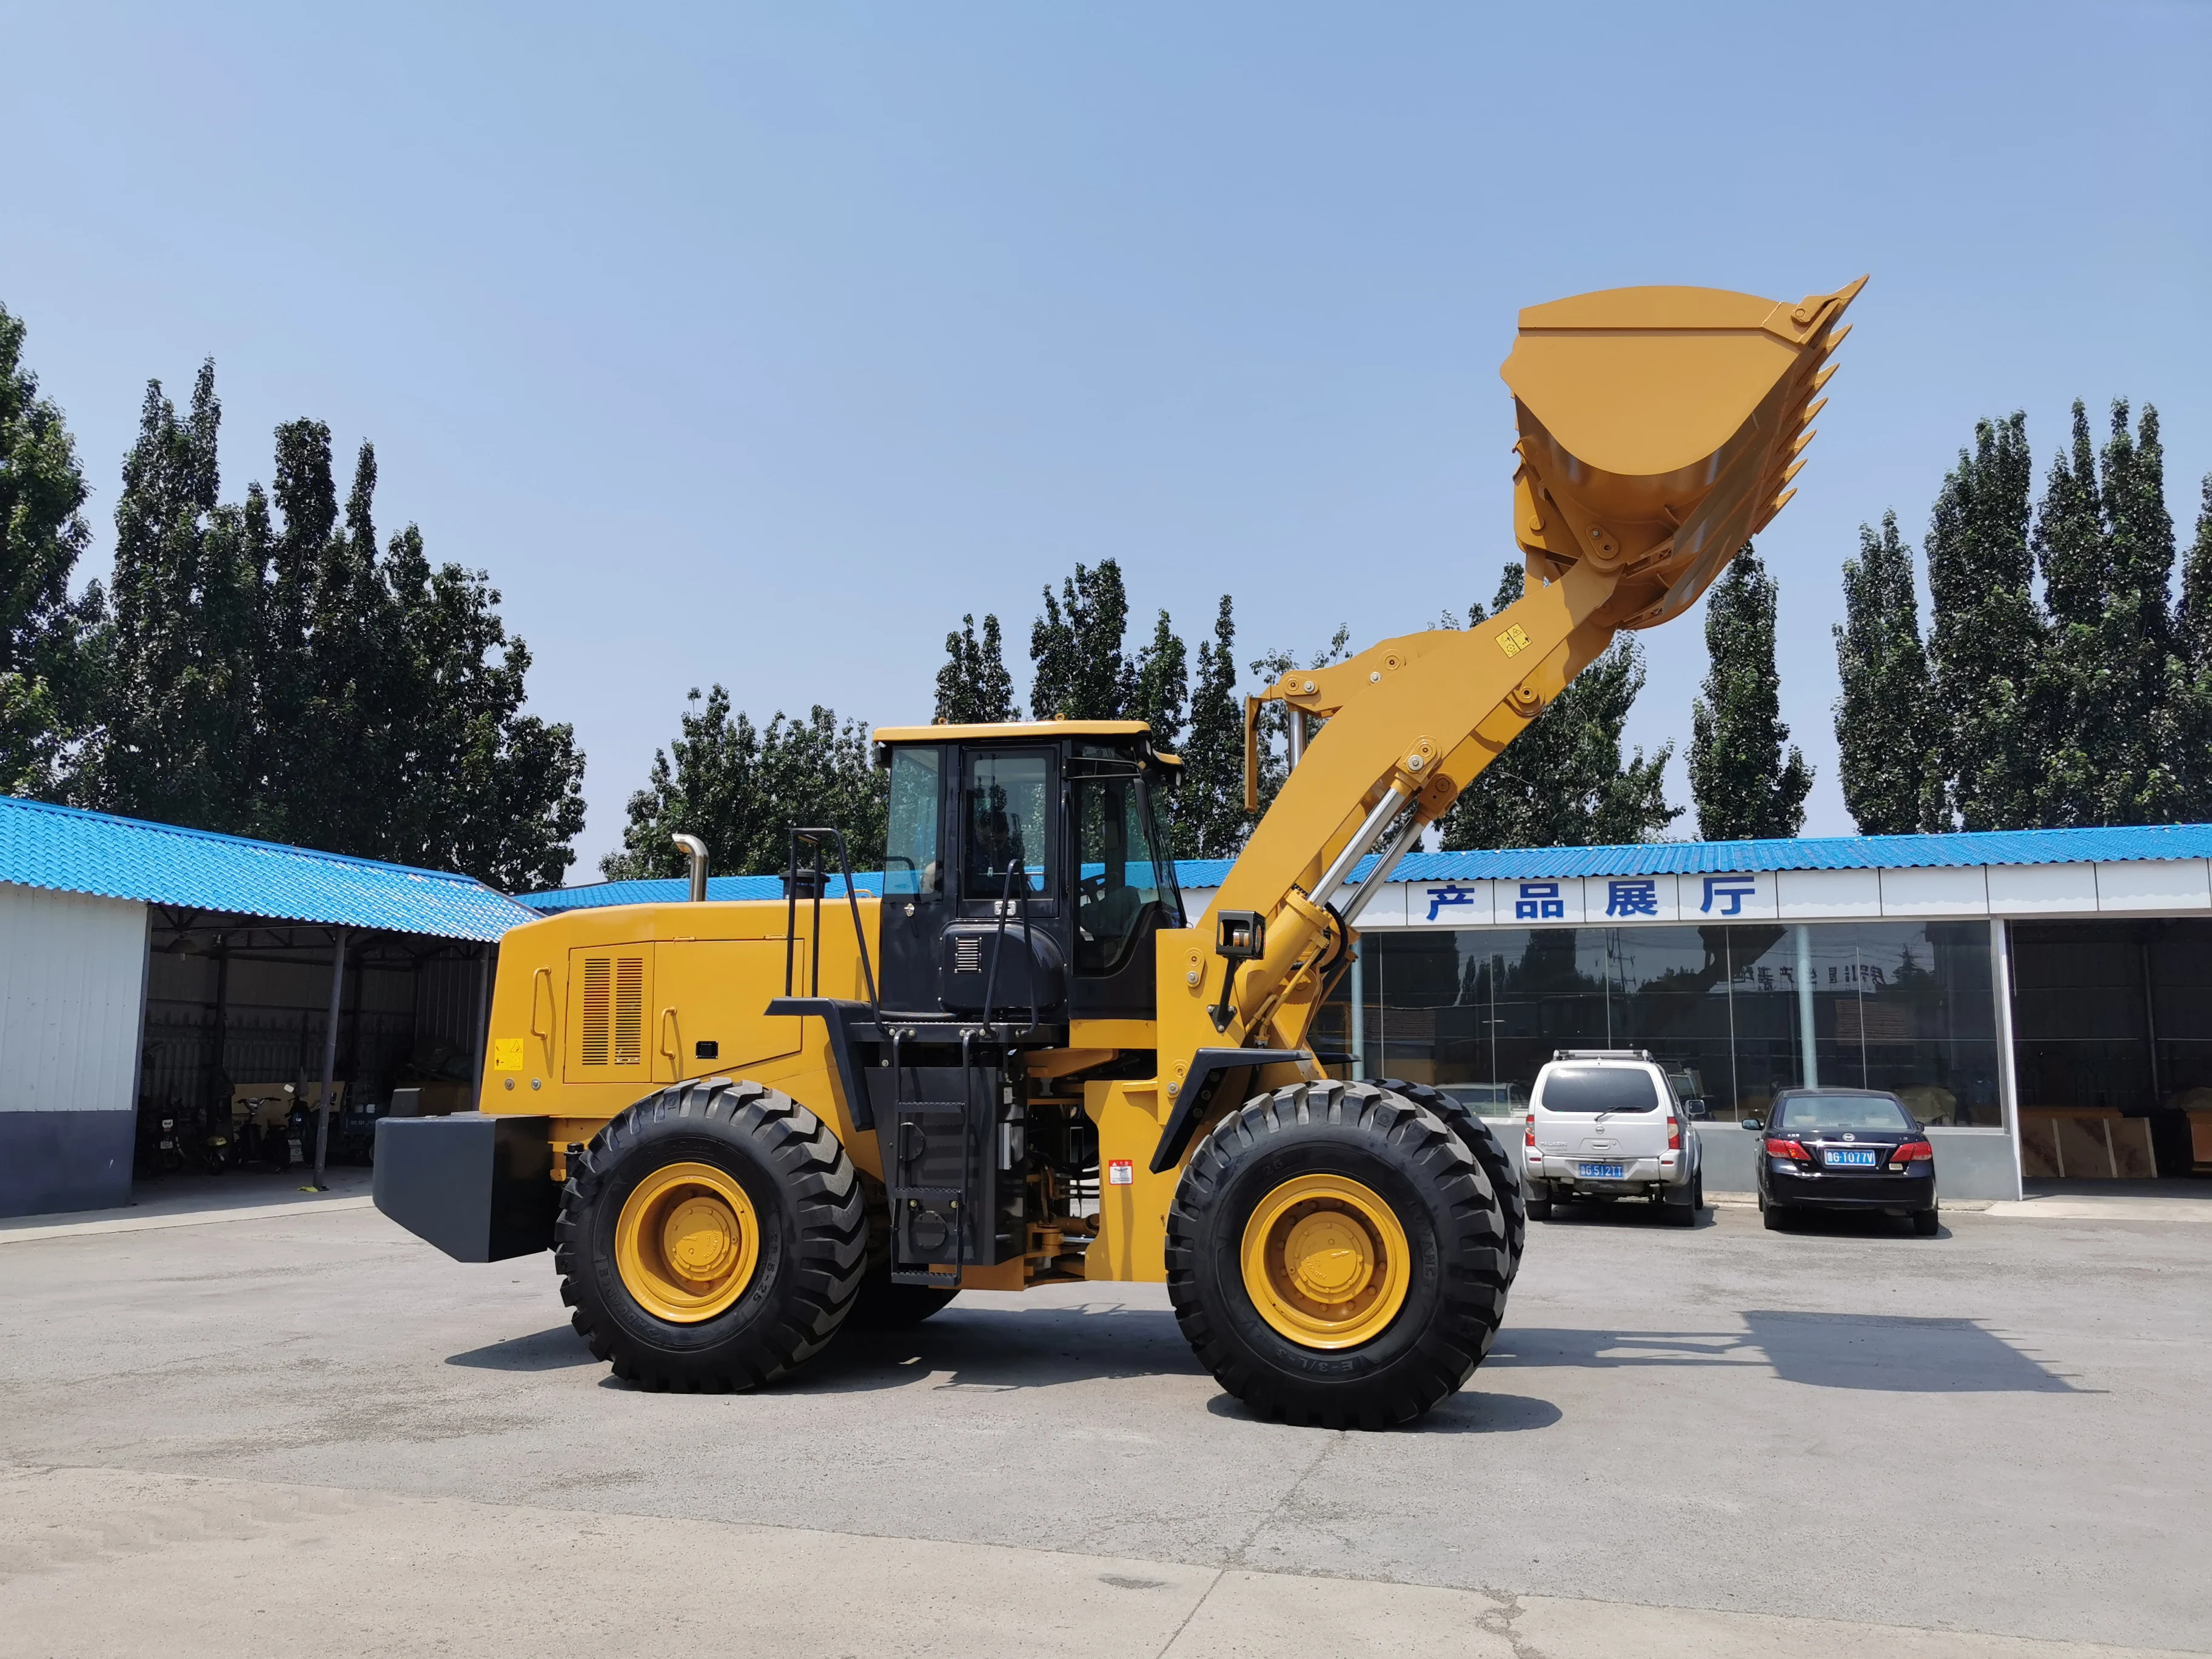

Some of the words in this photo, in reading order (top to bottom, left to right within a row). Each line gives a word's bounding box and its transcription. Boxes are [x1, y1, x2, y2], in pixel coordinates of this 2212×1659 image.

[1426, 876, 1755, 921] 产品展厅
[1276, 1349, 1355, 1373] E-3/L-3
